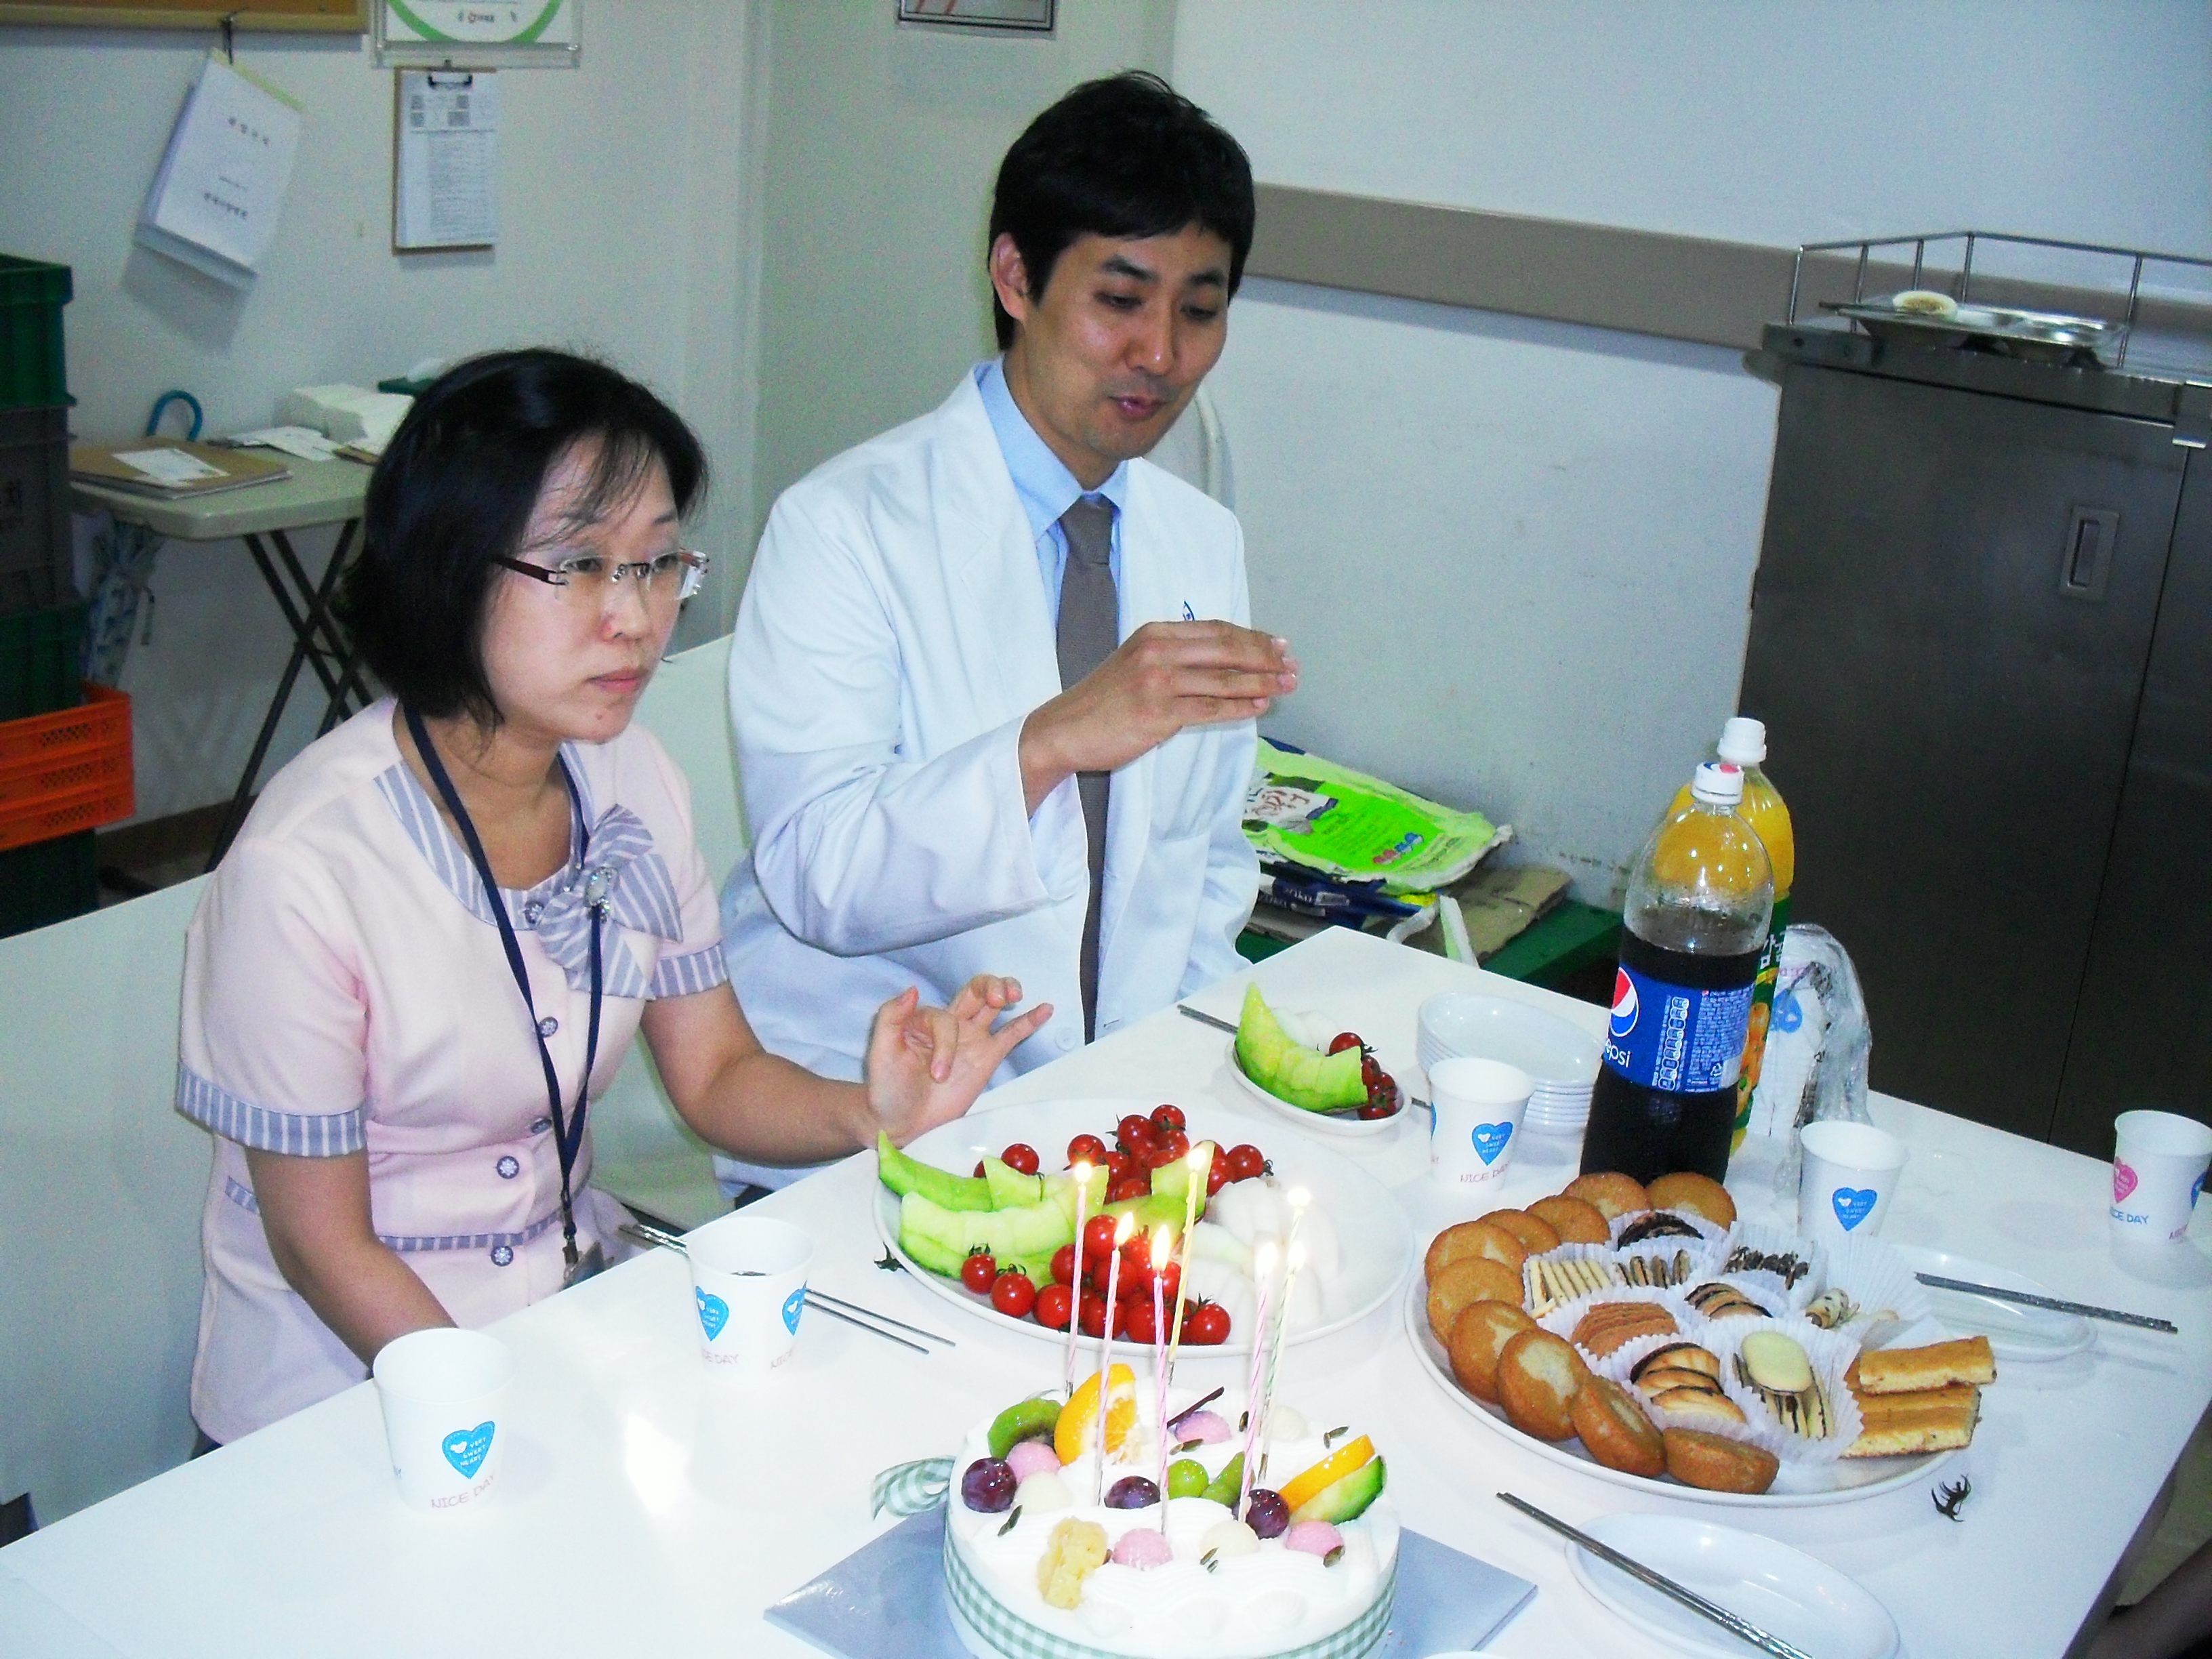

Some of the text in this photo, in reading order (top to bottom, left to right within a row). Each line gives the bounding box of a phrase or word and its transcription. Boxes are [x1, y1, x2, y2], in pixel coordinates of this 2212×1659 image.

[1605, 1038, 1631, 1068] epsi
[1460, 1160, 1510, 1183] NICE DAY
[2127, 1214, 2149, 1225] DAY
[714, 1354, 739, 1364] DAY
[431, 1471, 495, 1508] NICE DAY
